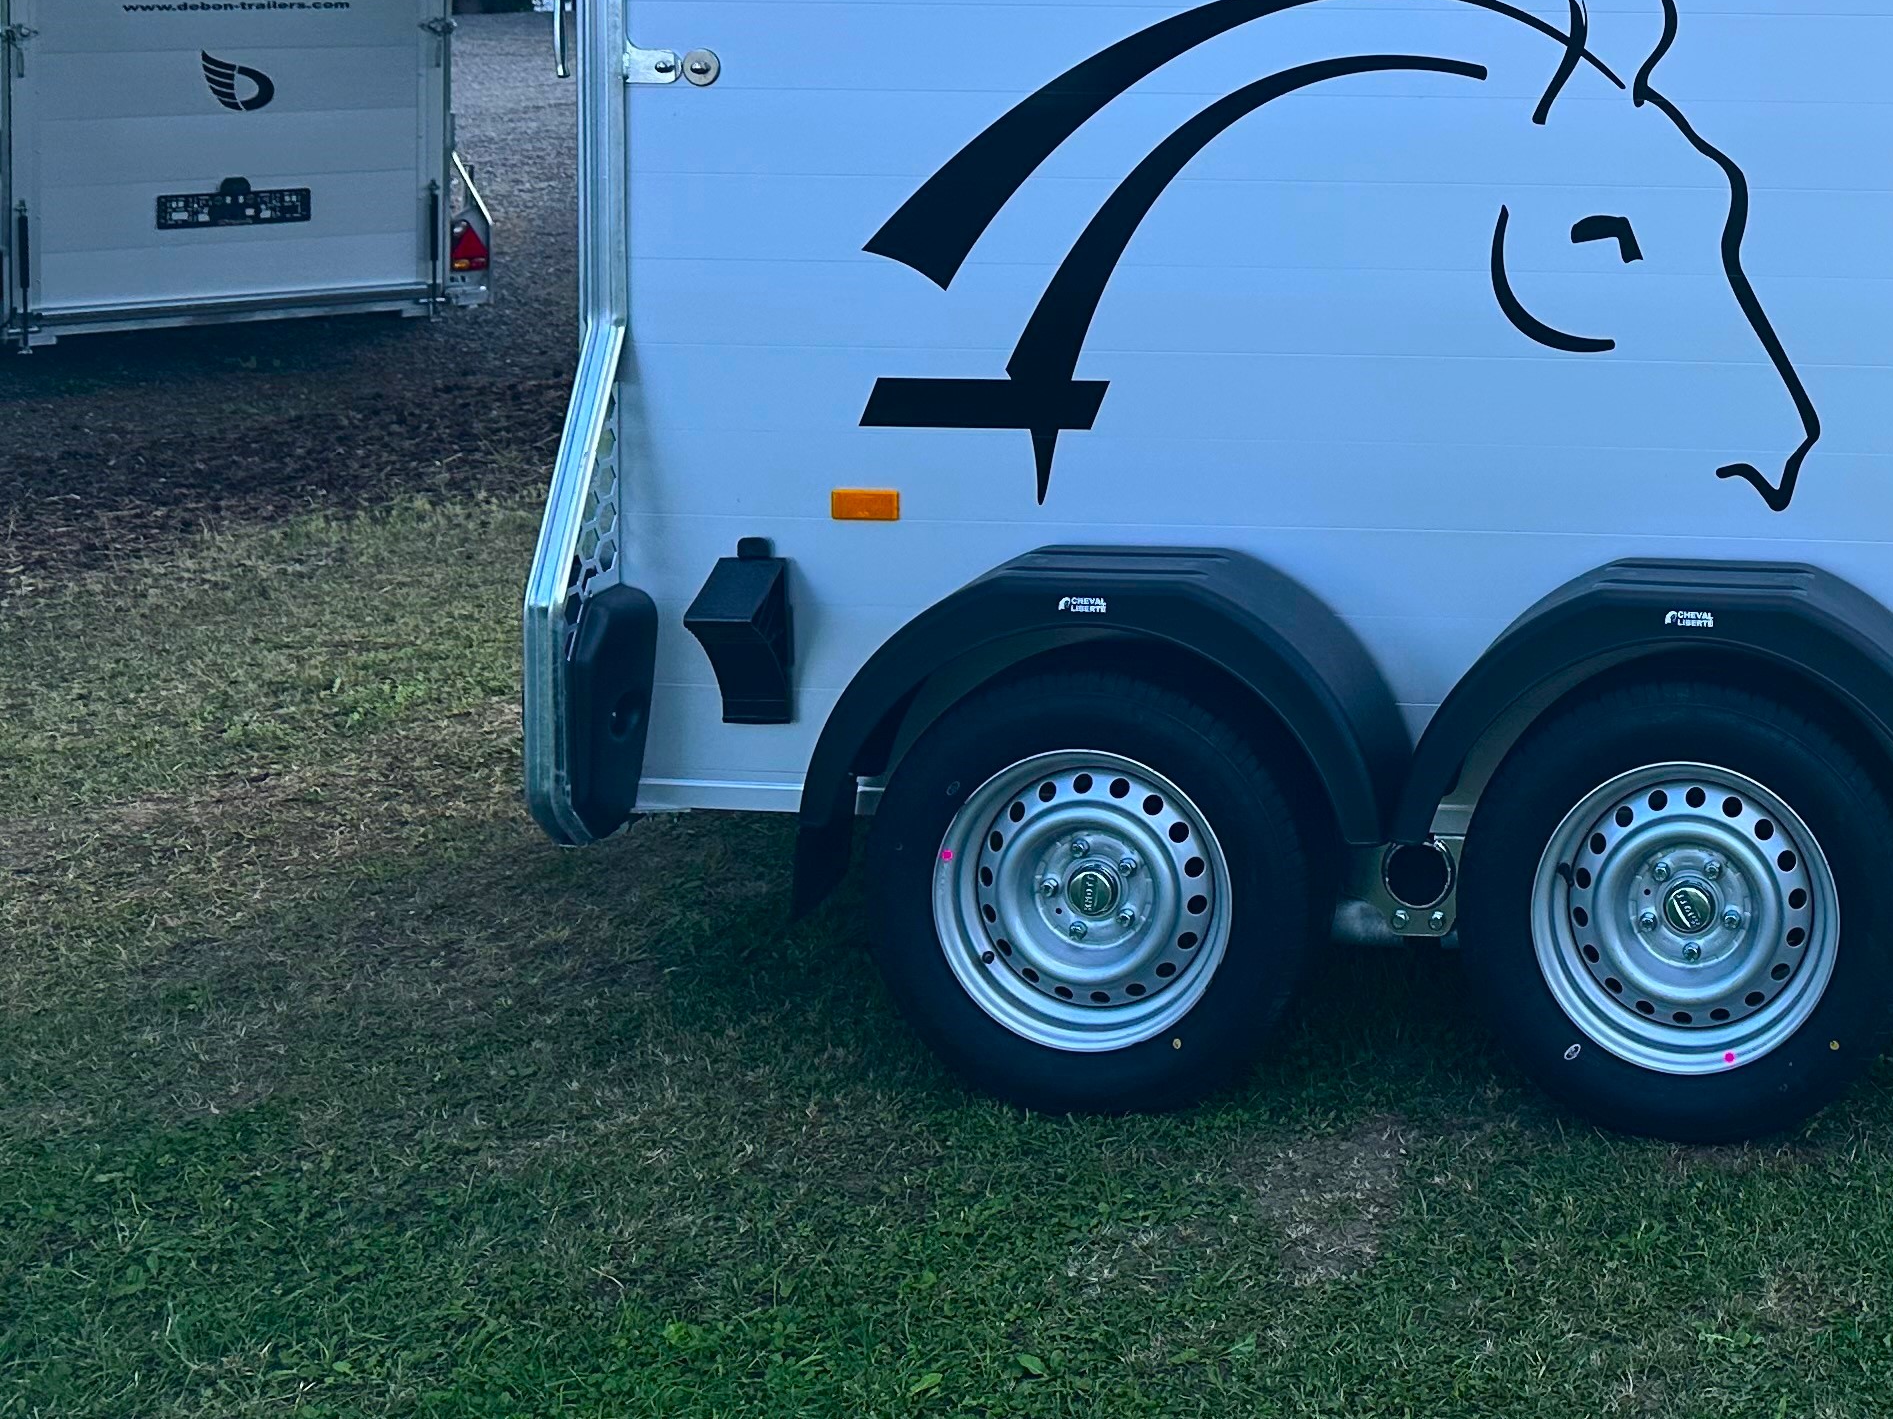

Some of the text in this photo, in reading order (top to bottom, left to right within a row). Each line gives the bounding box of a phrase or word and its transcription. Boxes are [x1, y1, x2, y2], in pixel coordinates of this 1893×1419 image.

[122, 0, 350, 12] www.debon-trailers.com
[1071, 597, 1106, 606] CHEVAL
[1677, 611, 1713, 619] CHEVAL
